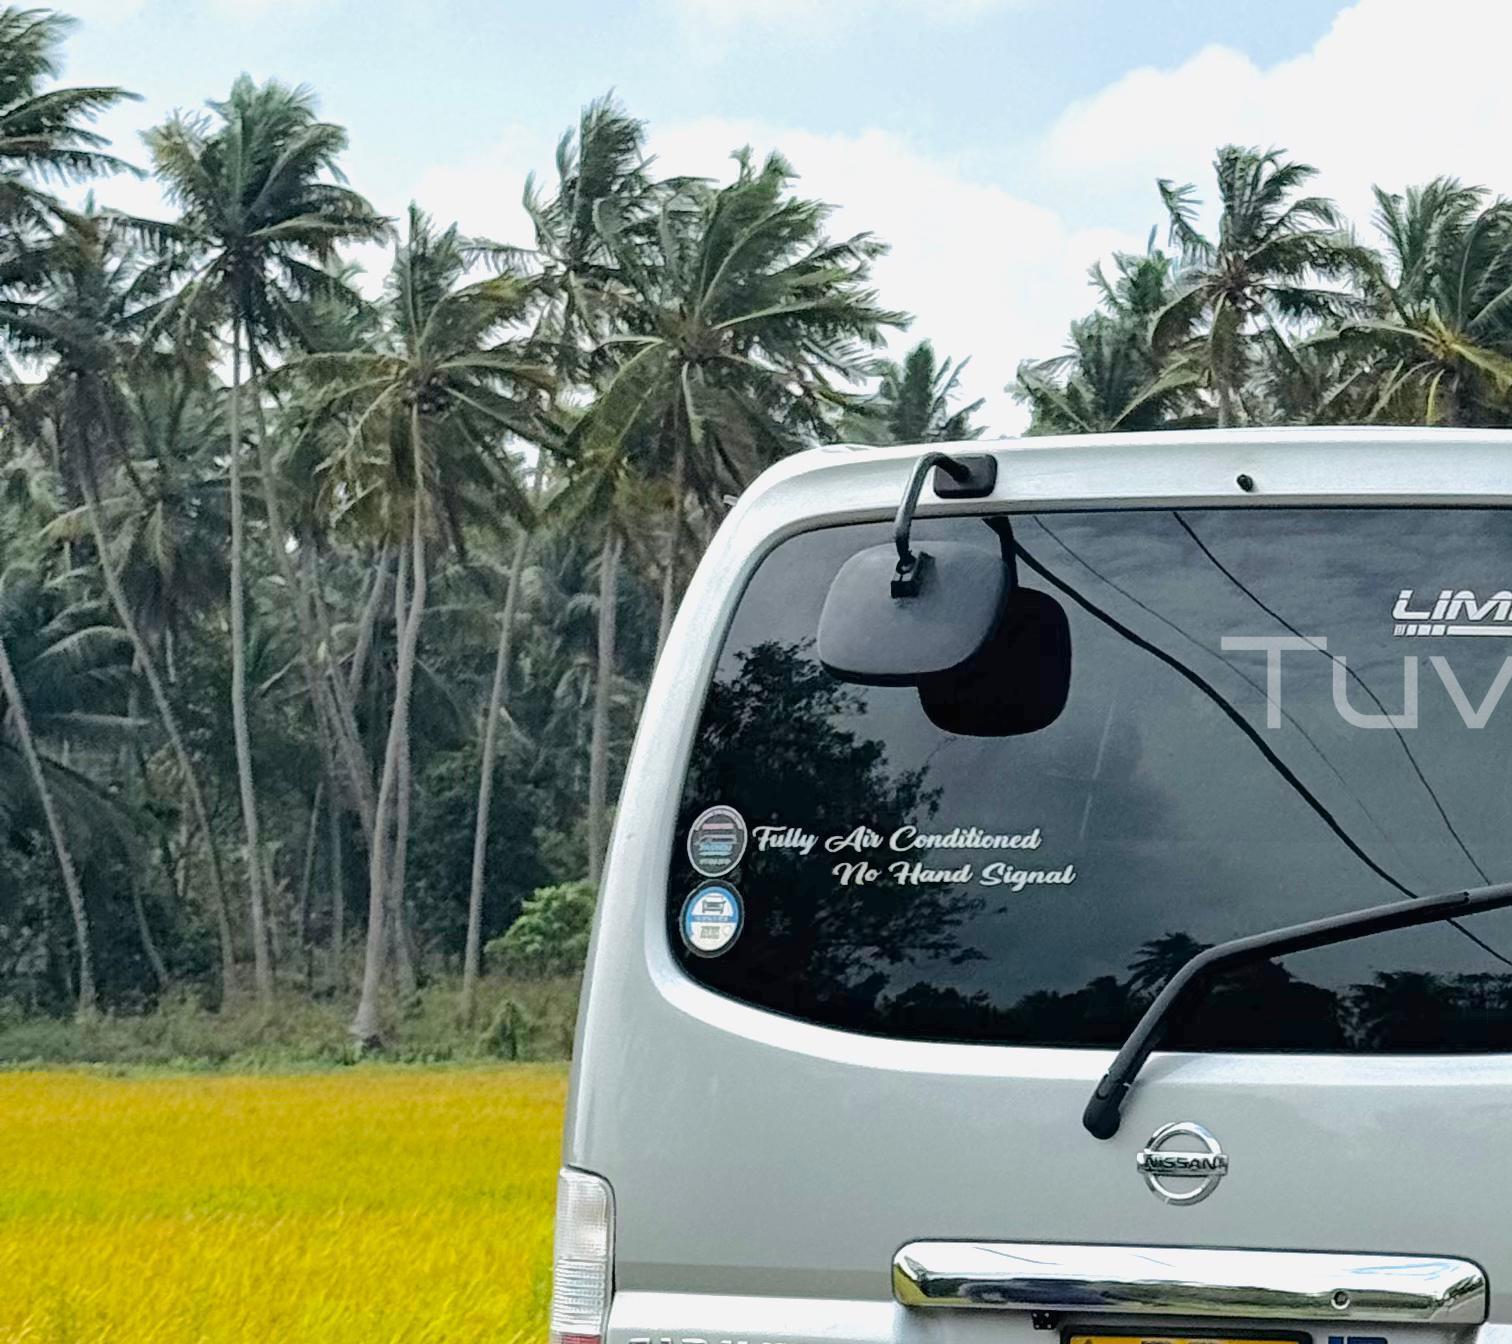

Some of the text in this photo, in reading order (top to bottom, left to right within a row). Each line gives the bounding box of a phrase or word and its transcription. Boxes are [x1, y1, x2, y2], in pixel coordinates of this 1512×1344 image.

[751, 825, 1042, 856] Fully Air Conditioned
[831, 860, 1077, 892] No Hand Signal
[1144, 1154, 1217, 1170] NISSAN
